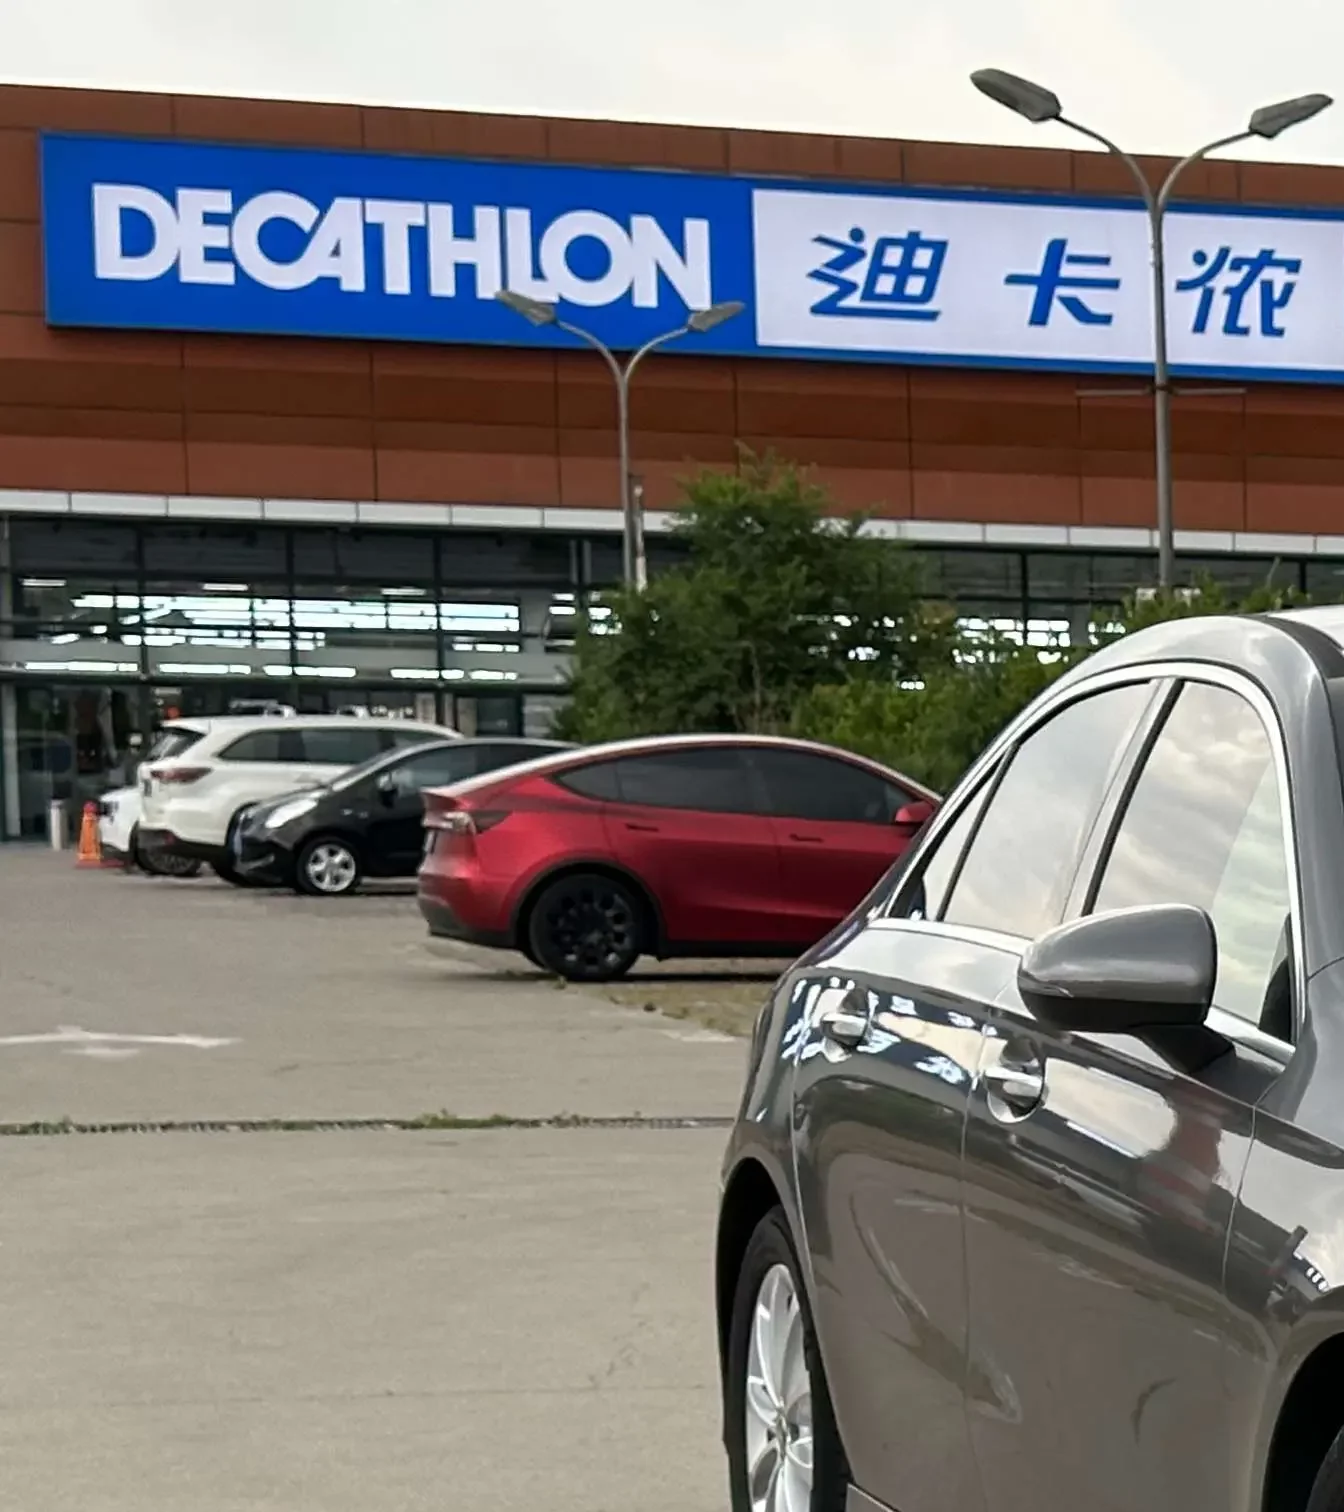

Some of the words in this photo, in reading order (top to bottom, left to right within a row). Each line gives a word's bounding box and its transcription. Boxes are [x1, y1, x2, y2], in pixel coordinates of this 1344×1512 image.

[93, 183, 711, 310] DECATHLON
[806, 226, 1302, 337] 迪卡侬
